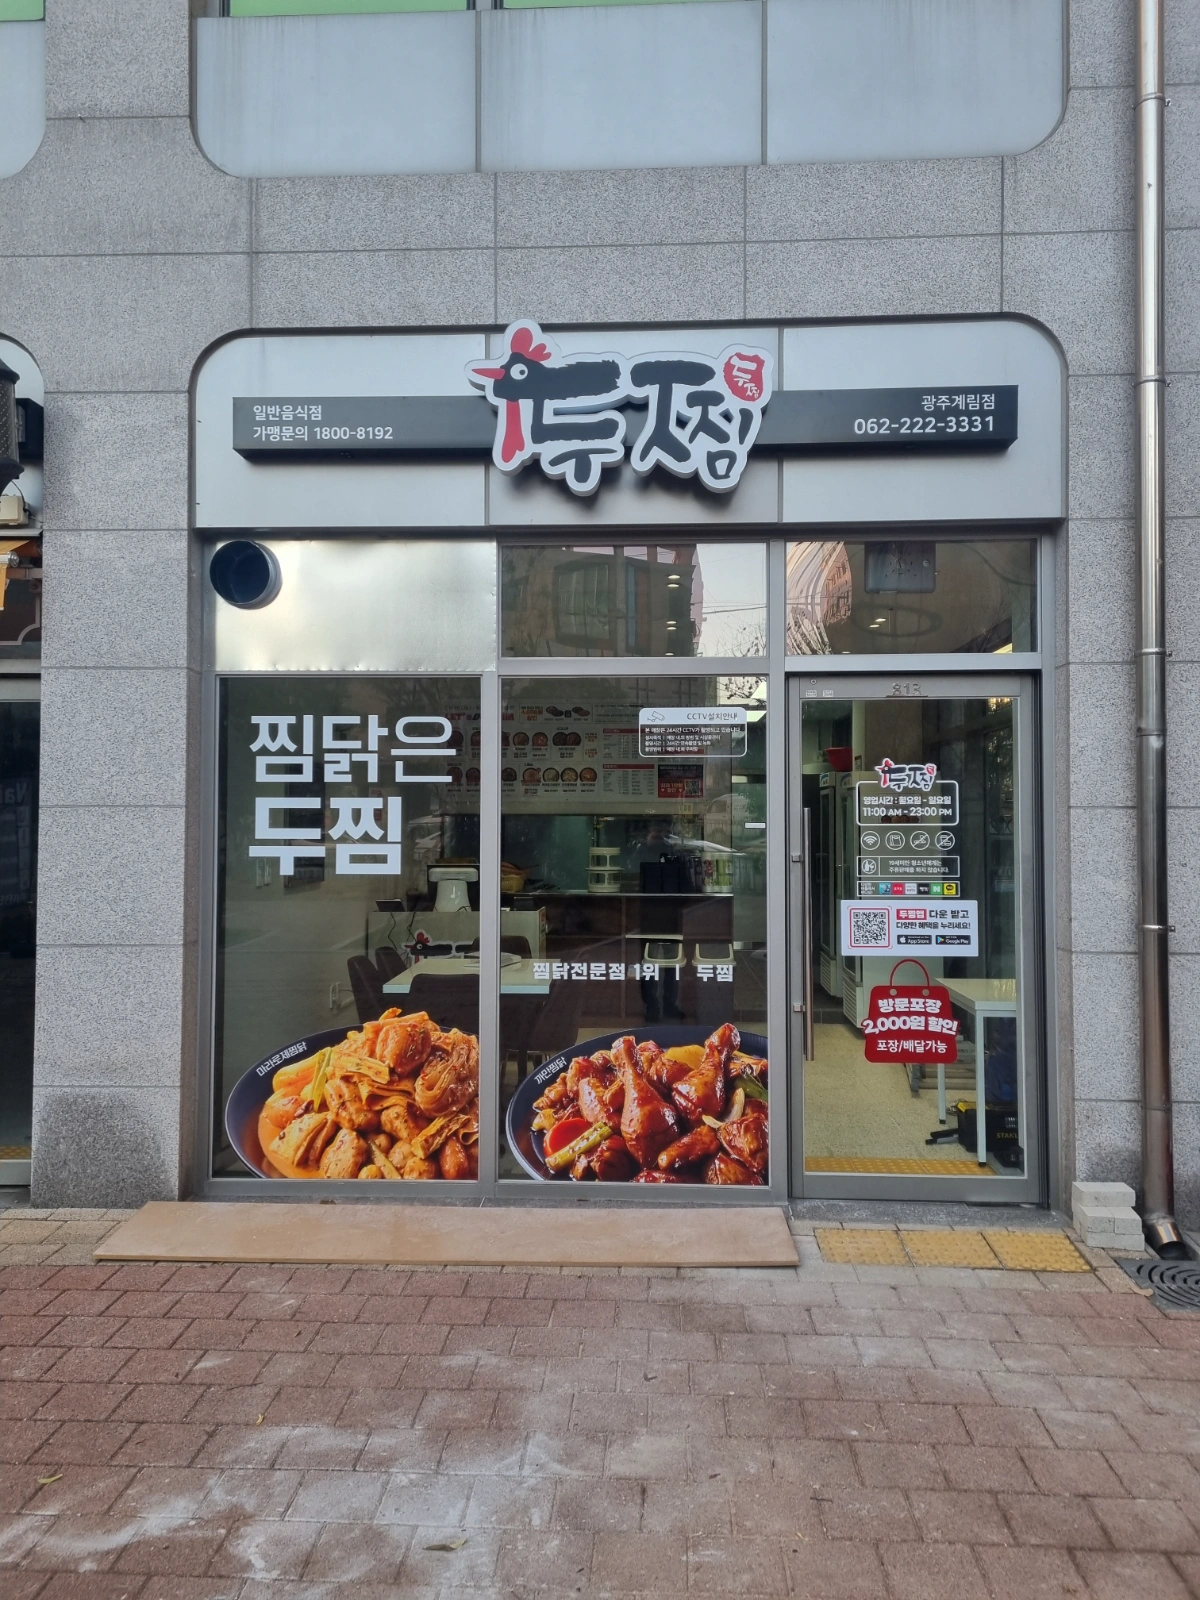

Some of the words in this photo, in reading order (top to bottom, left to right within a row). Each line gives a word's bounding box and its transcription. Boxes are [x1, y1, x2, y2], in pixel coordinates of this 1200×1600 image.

[920, 394, 995, 411] 광주계림점
[252, 404, 322, 421] 일반음식점
[492, 350, 754, 484] 두찜
[853, 415, 995, 434] 062-222-3331
[252, 425, 308, 442] 가맹문의
[314, 426, 394, 440] 1800-8192
[892, 682, 921, 696] 813
[686, 712, 738, 720] CCTV설치안내
[249, 714, 457, 783] 찜닭은
[863, 796, 894, 804] 영업시간
[899, 796, 922, 804] 월요일
[928, 796, 951, 804] 일요일
[863, 807, 886, 816] 11:00
[888, 808, 902, 816] AM
[910, 807, 937, 816] 23:00
[939, 808, 952, 816] PM
[248, 796, 402, 876] 두찜
[899, 910, 925, 919] 두찜앱
[929, 910, 948, 919] 다운
[951, 910, 969, 918] 받고
[533, 962, 625, 980] 찜닭전문점
[633, 963, 659, 981] 1위
[697, 964, 734, 982] 두찜
[878, 998, 942, 1013] 방문포장
[862, 1016, 925, 1034] 2,000원
[928, 1016, 958, 1035] 할인
[877, 1039, 948, 1053] 포장/배달가능
[256, 1041, 308, 1076] 마라로제찜닭
[534, 1056, 568, 1084] 까만찜닭
